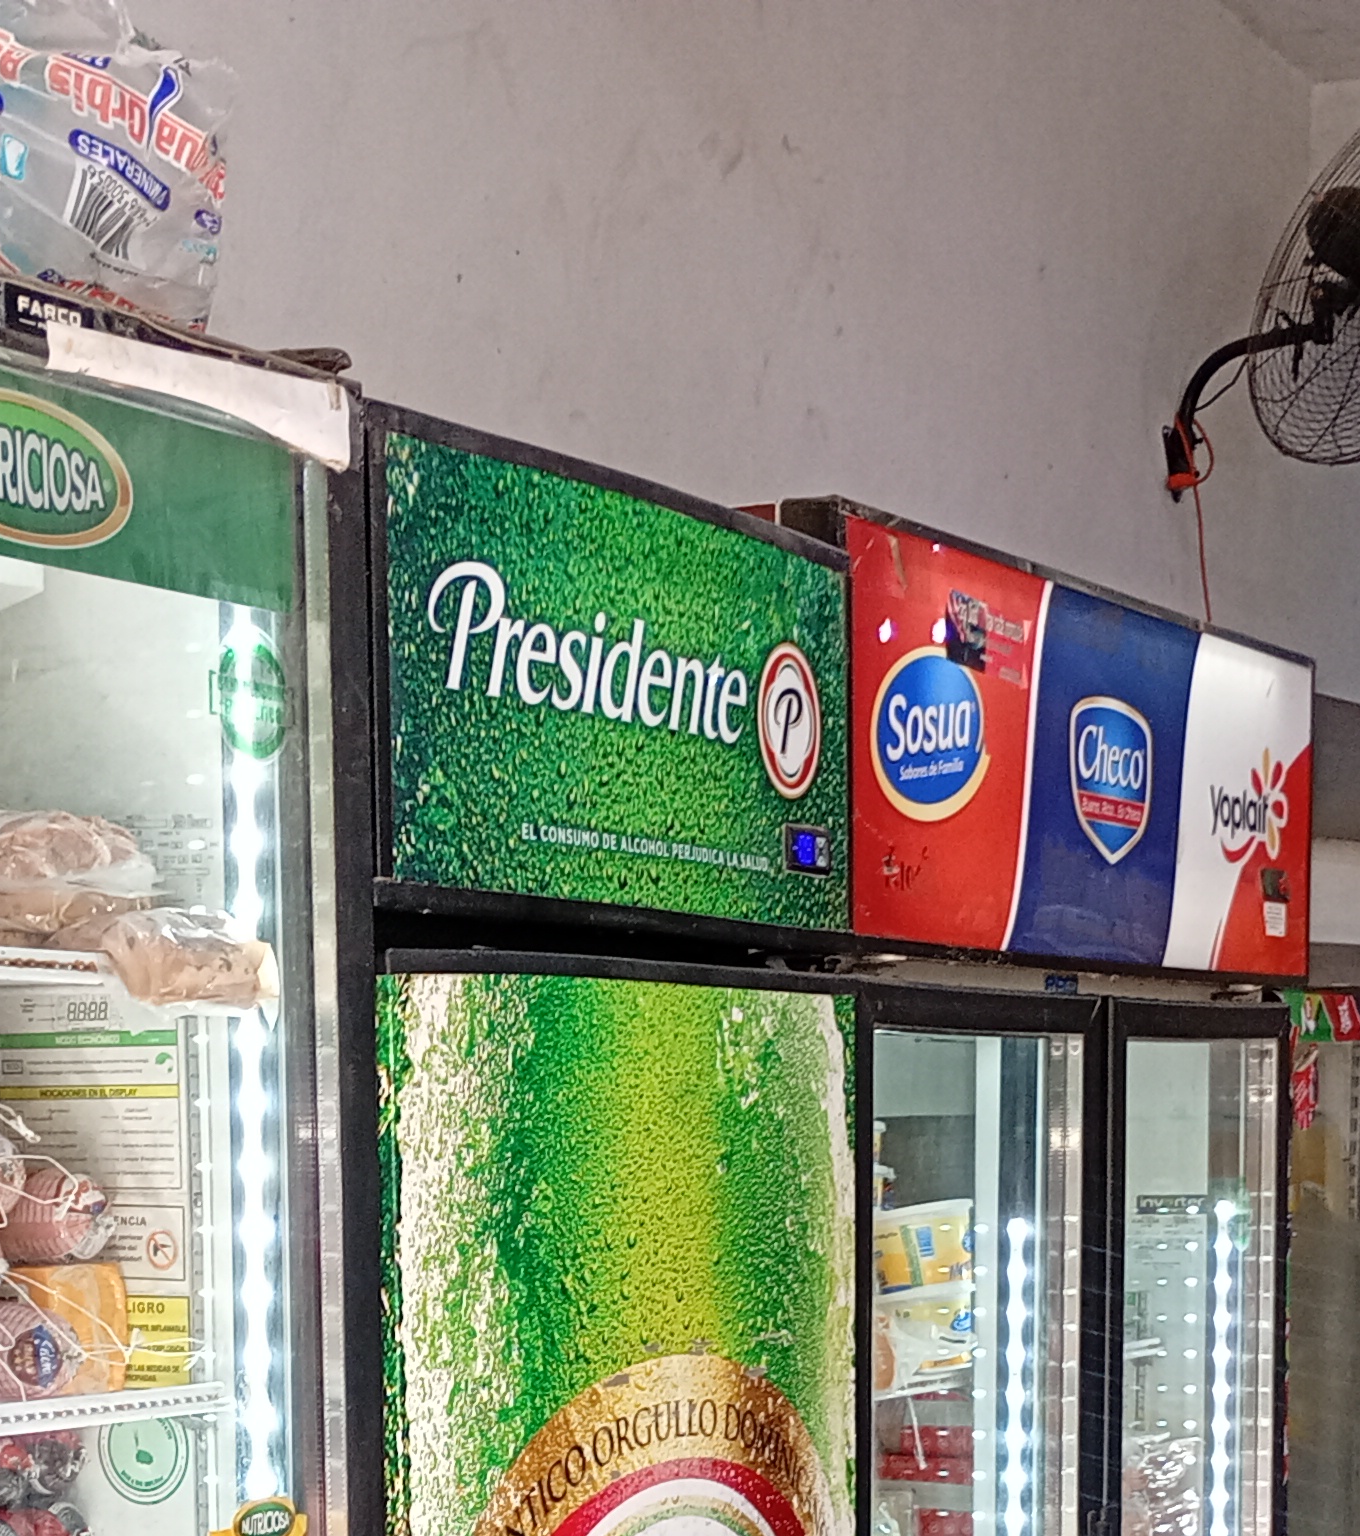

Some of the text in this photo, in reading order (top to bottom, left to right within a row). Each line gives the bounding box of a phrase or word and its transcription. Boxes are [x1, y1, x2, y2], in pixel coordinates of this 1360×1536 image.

[16, 294, 84, 328] FARCO
[427, 559, 748, 745] Presidente
[886, 693, 971, 762] Sosua
[1077, 724, 1144, 790] Checo
[1209, 784, 1269, 840] Yoplait
[521, 822, 537, 841] EL
[540, 824, 599, 848] CONSUMO
[602, 832, 617, 850] DE
[620, 835, 670, 858] ALCOHOL
[672, 843, 725, 866] PERJUDICA
[726, 851, 739, 868] LA
[127, 1301, 166, 1315] LIGRO
[590, 1397, 718, 1470] ORGULLO
[241, 1511, 291, 1536] NUTRICIOSA
